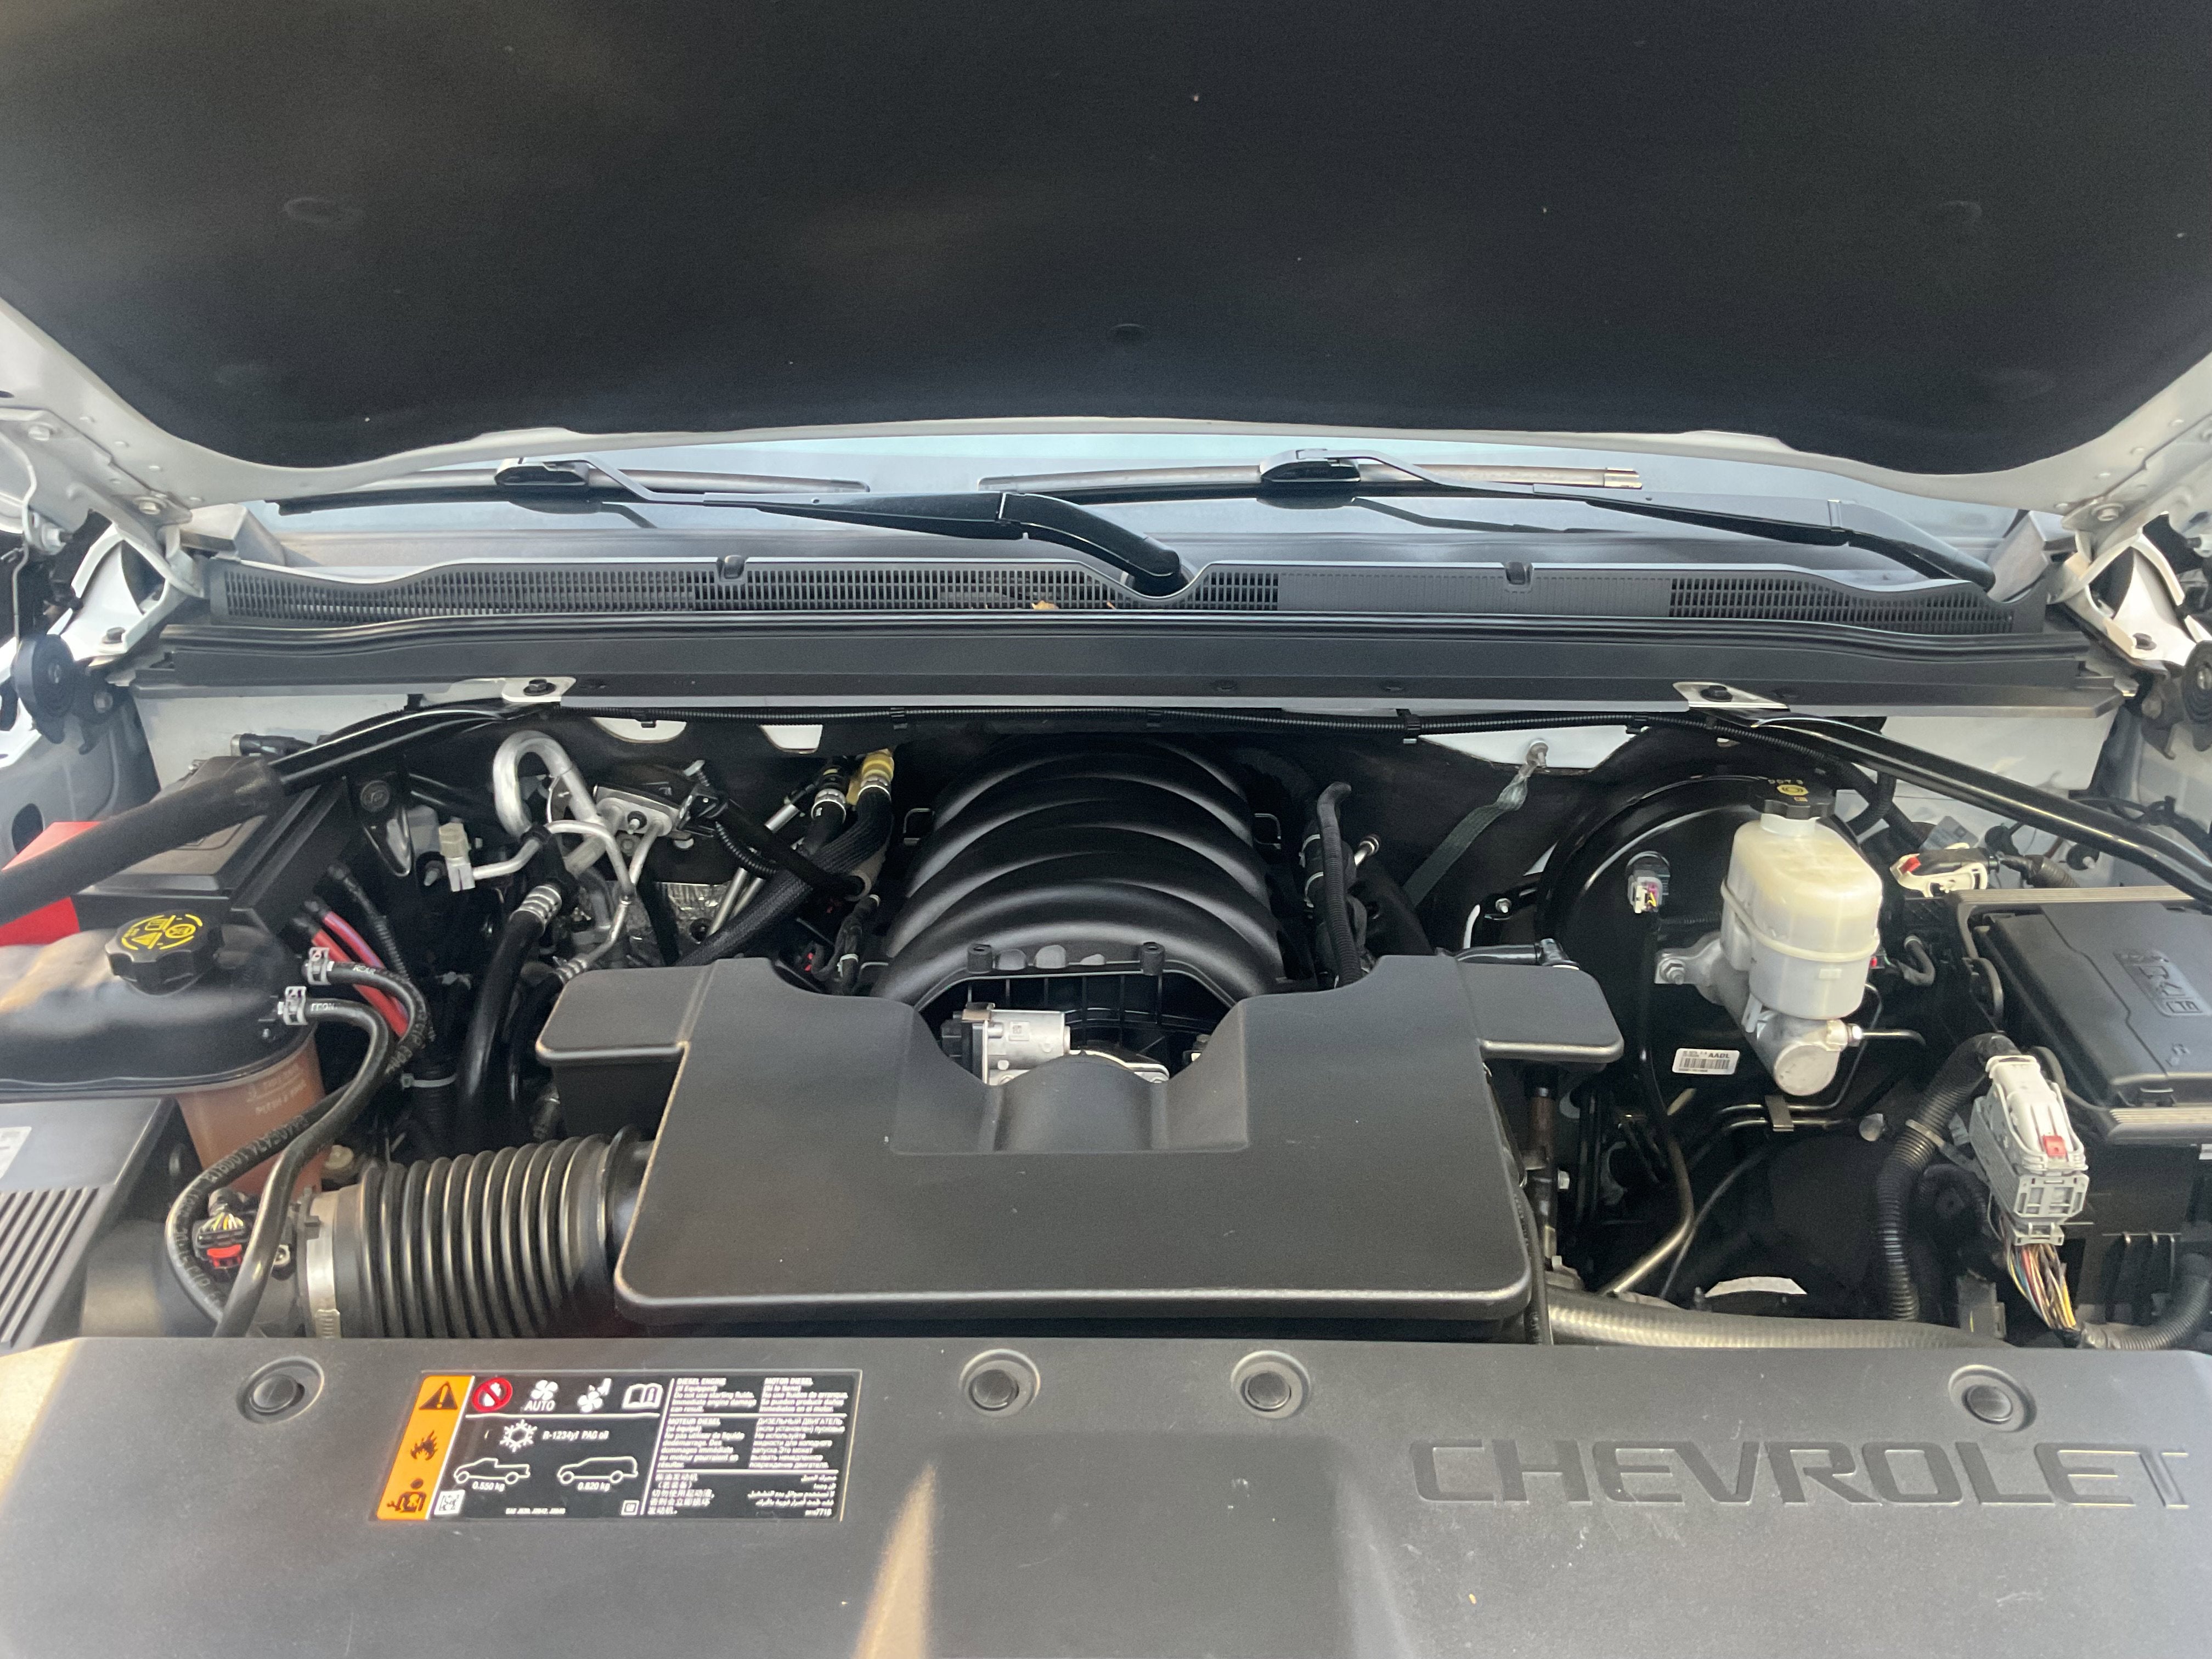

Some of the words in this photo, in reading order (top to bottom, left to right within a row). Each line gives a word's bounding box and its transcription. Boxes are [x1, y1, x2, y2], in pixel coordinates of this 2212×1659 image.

[701, 1378, 726, 1386] ENGINE
[789, 1378, 813, 1386] DIESEL
[524, 1400, 555, 1412] AUTO
[697, 1418, 721, 1426] DIESEL
[542, 1430, 579, 1441] R-1234yf
[582, 1430, 597, 1440] PAG
[599, 1430, 610, 1440] oil
[1408, 1440, 2190, 1510] CHEVROLET
[472, 1481, 494, 1490] 0.550
[494, 1482, 505, 1492] kg
[600, 1482, 611, 1492] kg
